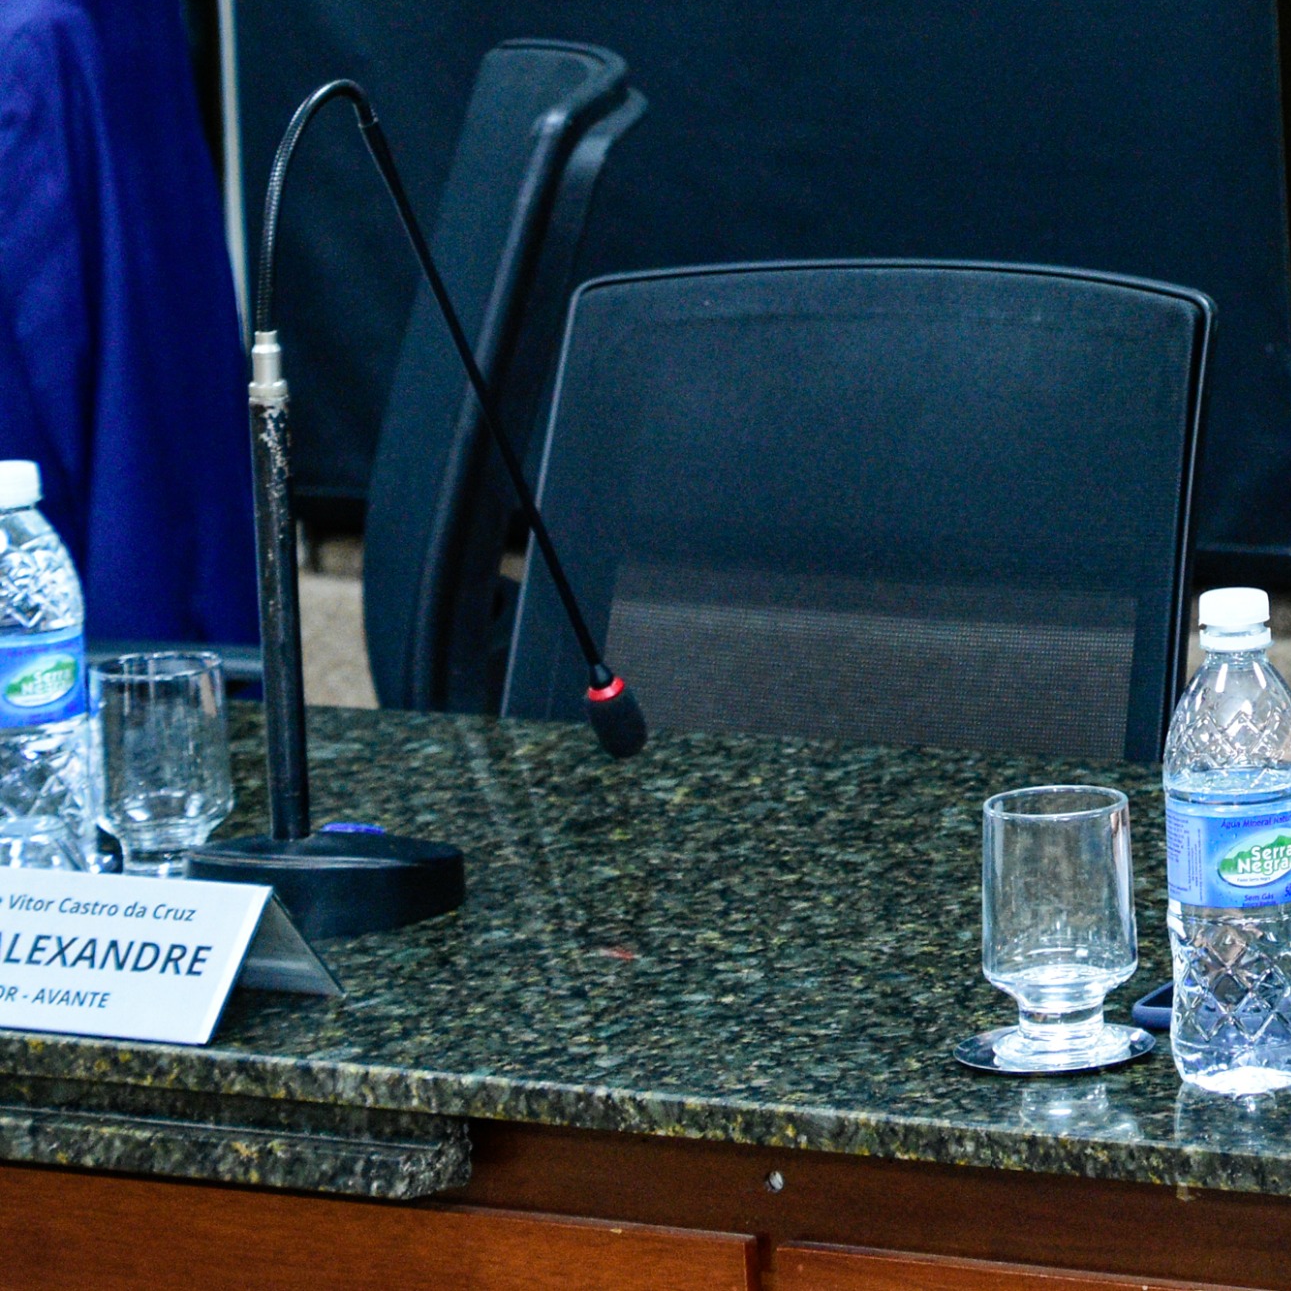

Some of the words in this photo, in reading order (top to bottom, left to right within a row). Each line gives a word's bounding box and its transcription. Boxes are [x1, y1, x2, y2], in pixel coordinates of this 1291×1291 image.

[1237, 857, 1289, 875] Negra
[8, 893, 54, 912] Vitor
[58, 897, 119, 917] Castro
[123, 901, 147, 918] da
[152, 903, 196, 922] Cruz
[0, 931, 213, 977] LEXANDRE
[32, 988, 110, 1009] AVANTE
